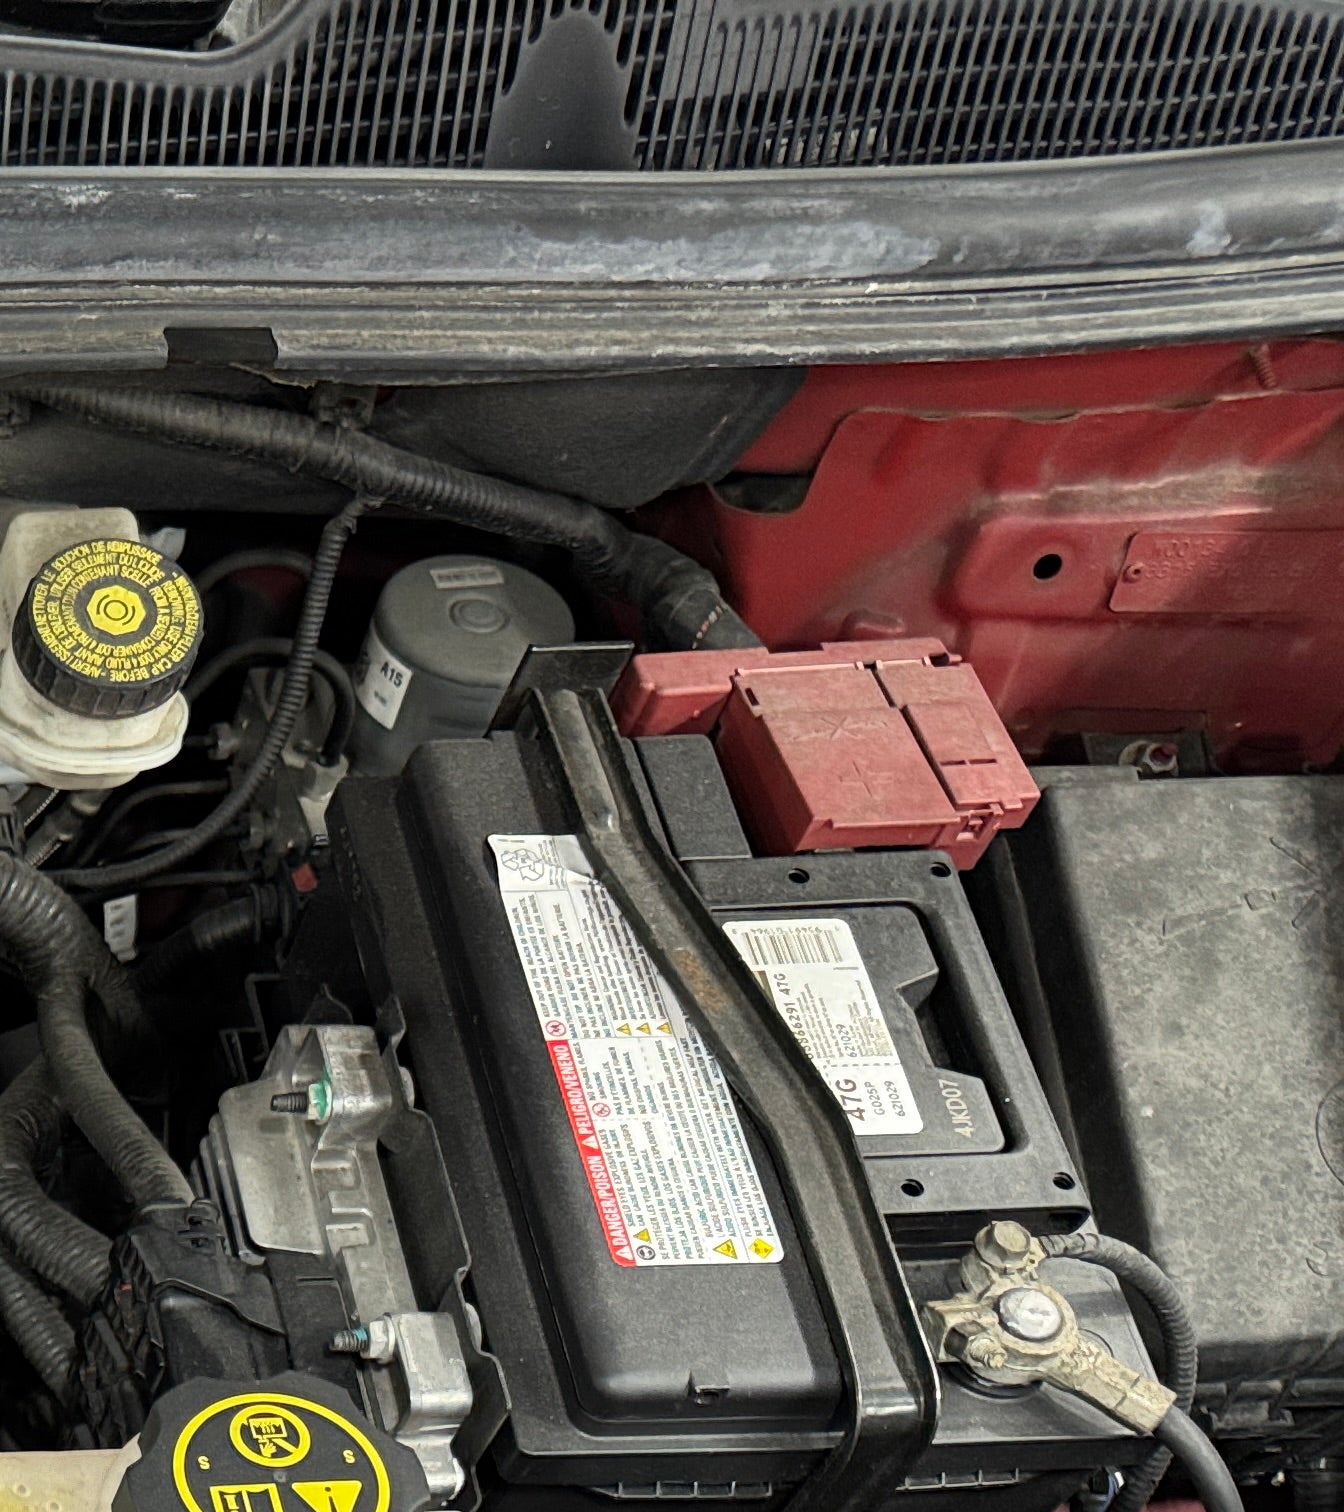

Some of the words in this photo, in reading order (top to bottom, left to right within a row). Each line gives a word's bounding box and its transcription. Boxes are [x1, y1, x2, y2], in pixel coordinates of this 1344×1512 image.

[380, 661, 403, 688] A15
[774, 973, 791, 996] 47G
[784, 1002, 814, 1060] 866291
[553, 1045, 594, 1135] PELIGRO/VENENO
[835, 1078, 865, 1121] 47G
[884, 1080, 906, 1117] 621029
[939, 1079, 975, 1138] 4JKD07
[586, 1155, 628, 1245] DANGER/POISON
